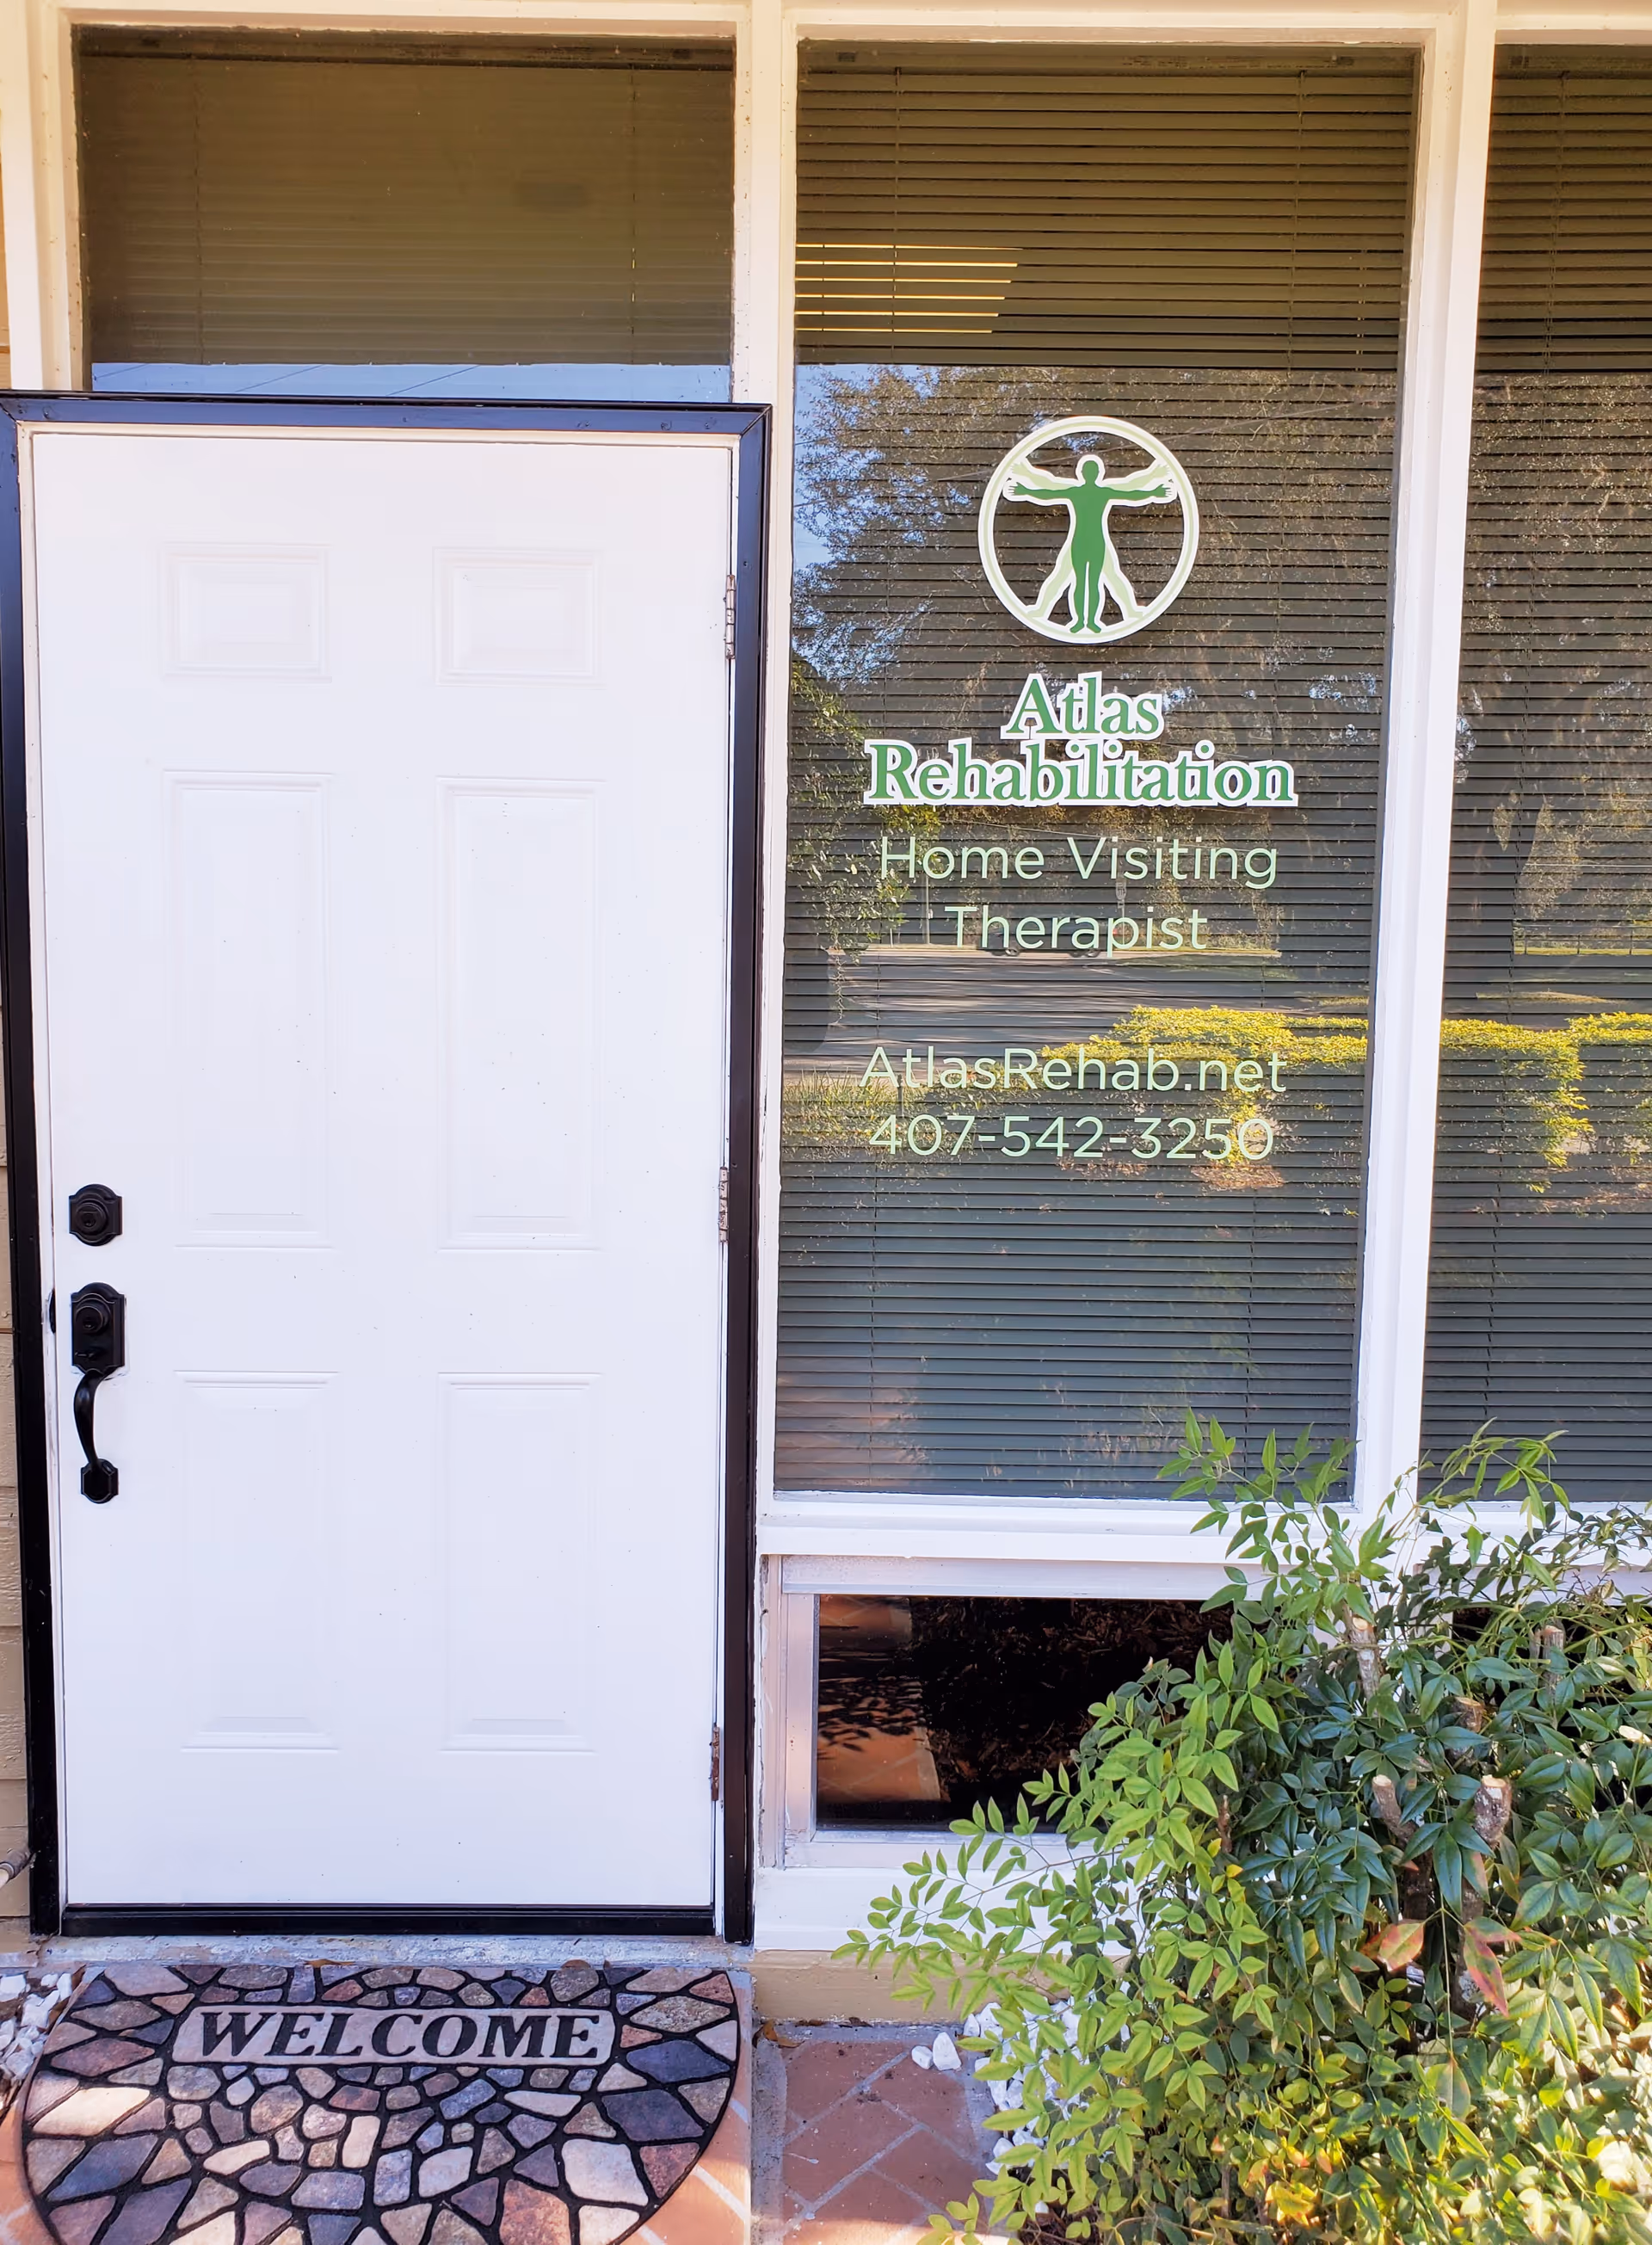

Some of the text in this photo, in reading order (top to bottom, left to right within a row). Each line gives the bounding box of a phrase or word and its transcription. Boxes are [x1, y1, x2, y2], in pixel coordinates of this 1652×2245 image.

[1005, 675, 1162, 737] Atlas
[867, 740, 1297, 804] Rehabilitation
[880, 836, 1277, 890] Home Visiting
[945, 905, 1208, 958] Therapist
[860, 1045, 1287, 1093] AtlasRehab.net
[868, 1114, 1274, 1160] 407-542-3250
[200, 2012, 600, 2059] WELCOME
